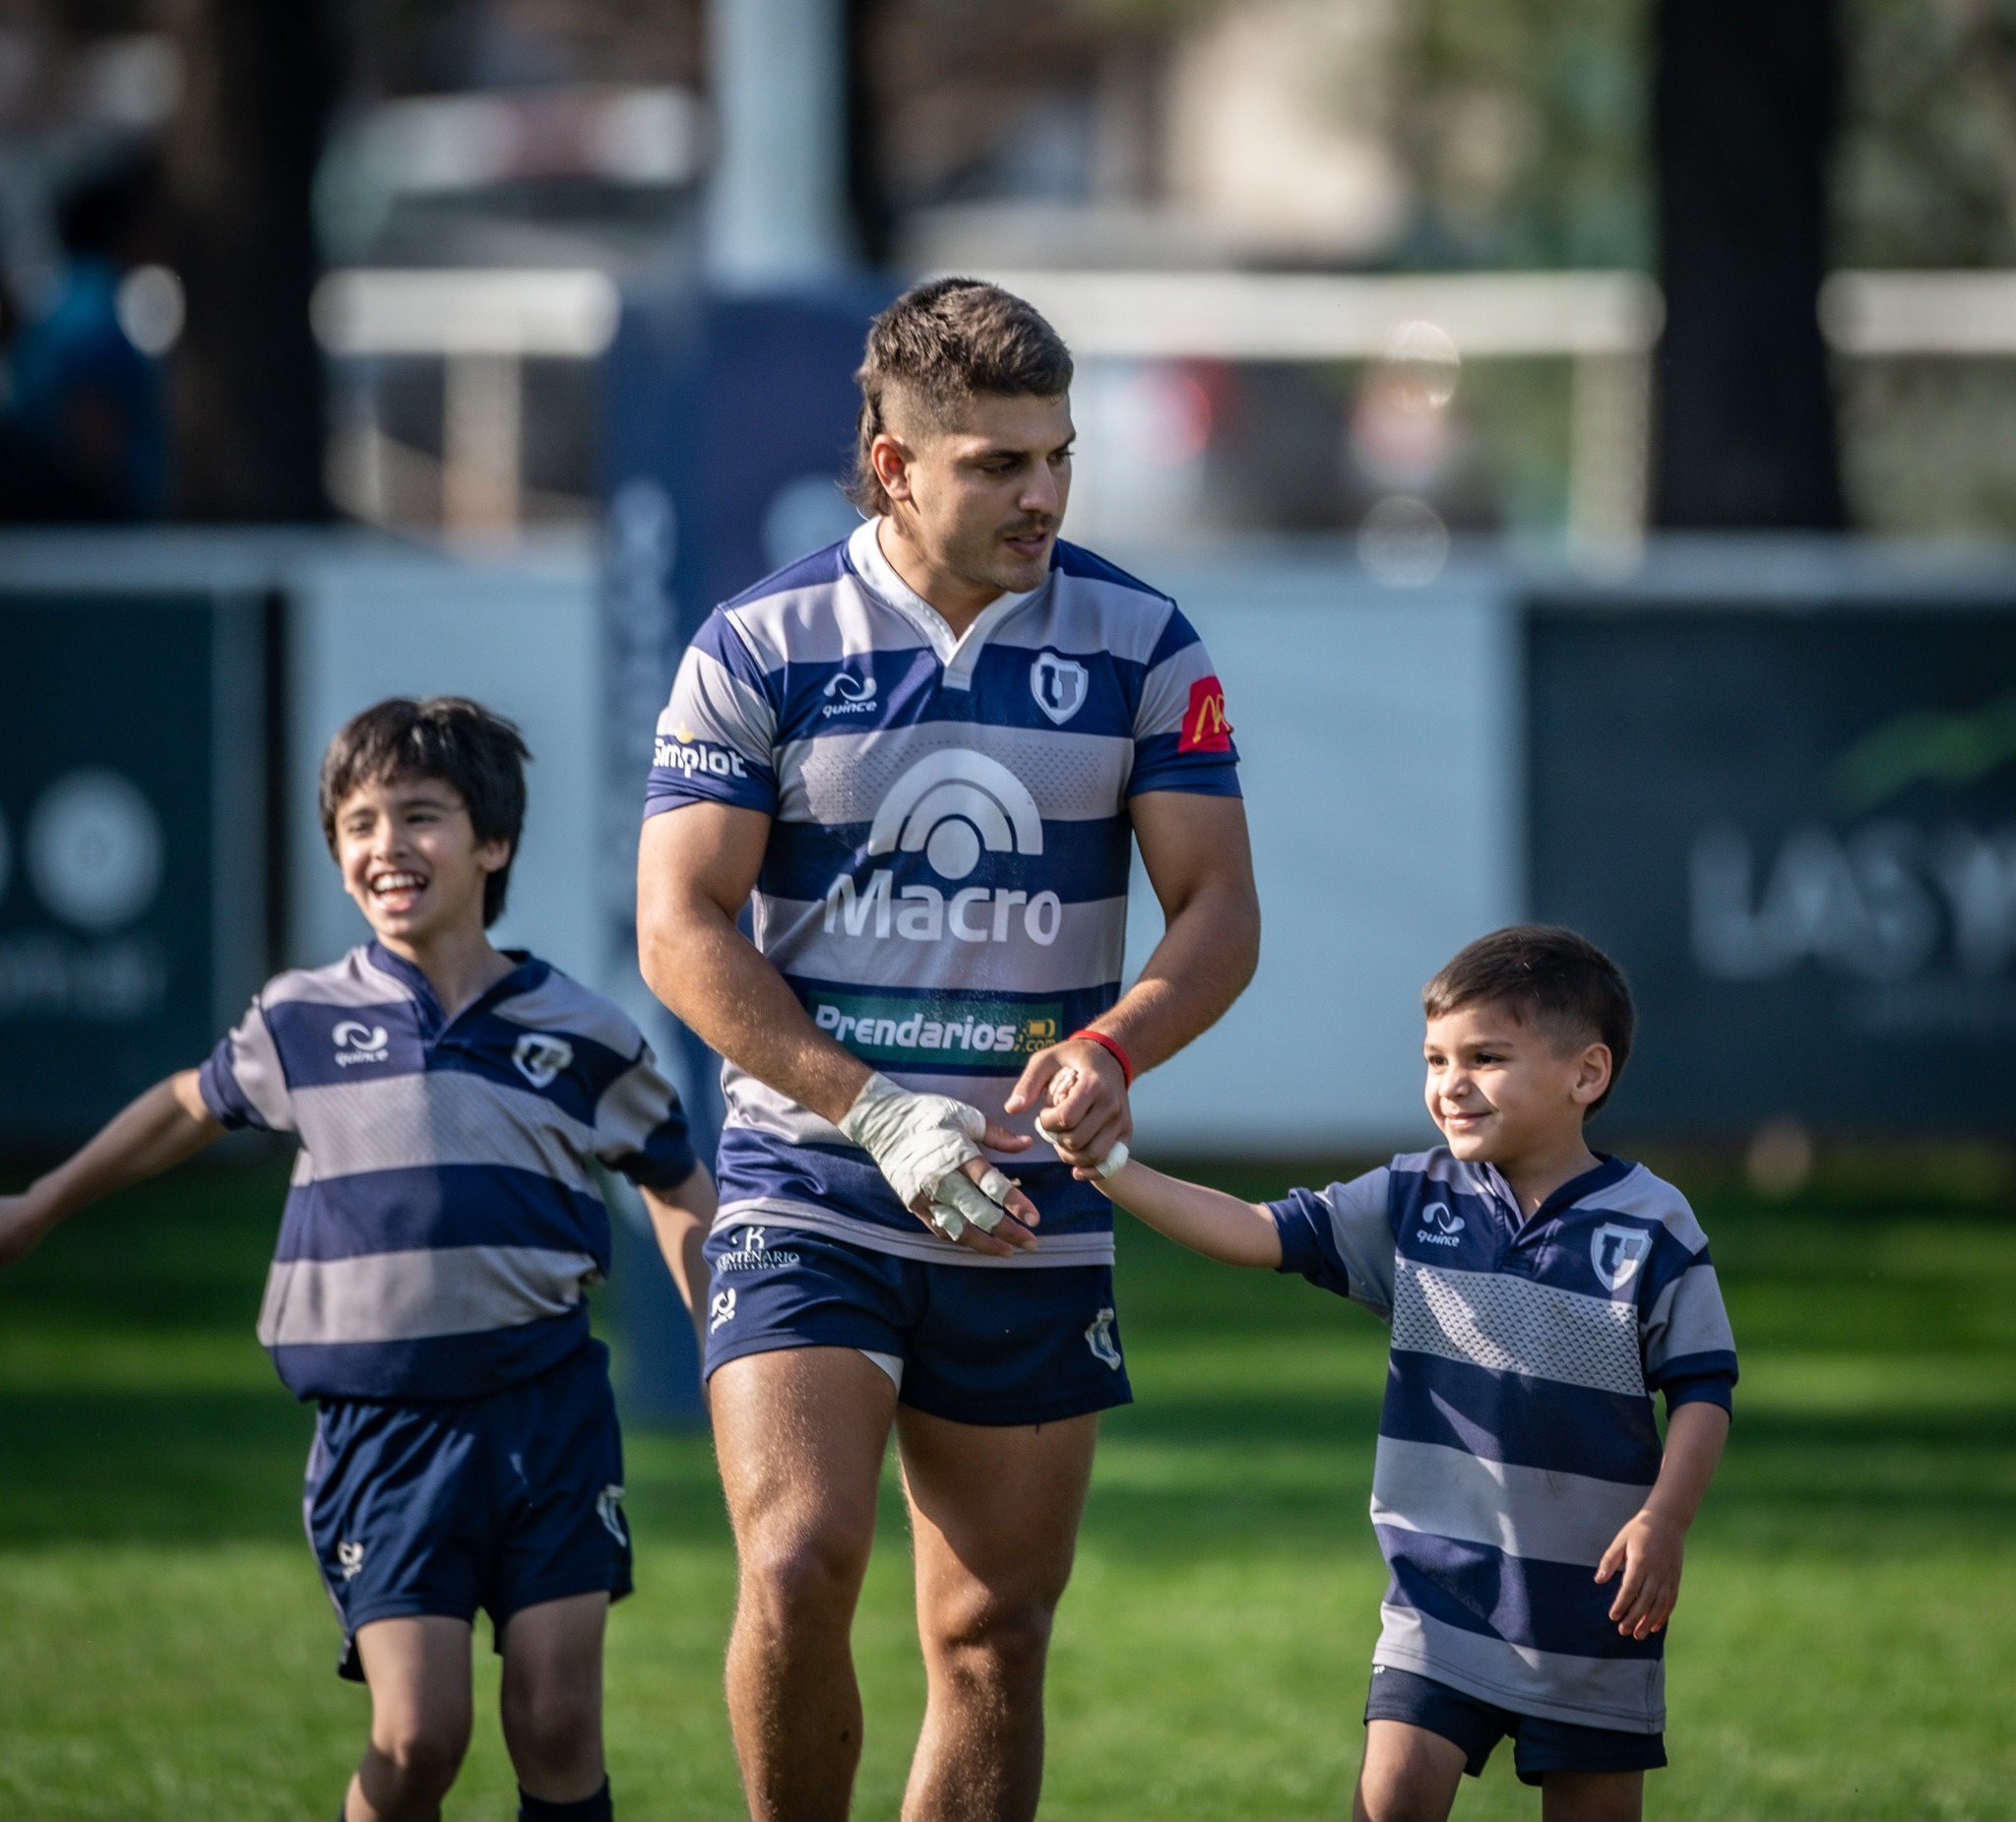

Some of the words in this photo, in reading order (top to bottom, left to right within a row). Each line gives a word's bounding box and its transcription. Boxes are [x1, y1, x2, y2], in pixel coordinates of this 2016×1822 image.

[822, 700, 878, 719] quince
[823, 869, 1062, 946] Macro
[815, 1004, 1017, 1052] Prendarios
[1416, 1229, 1461, 1247] quince
